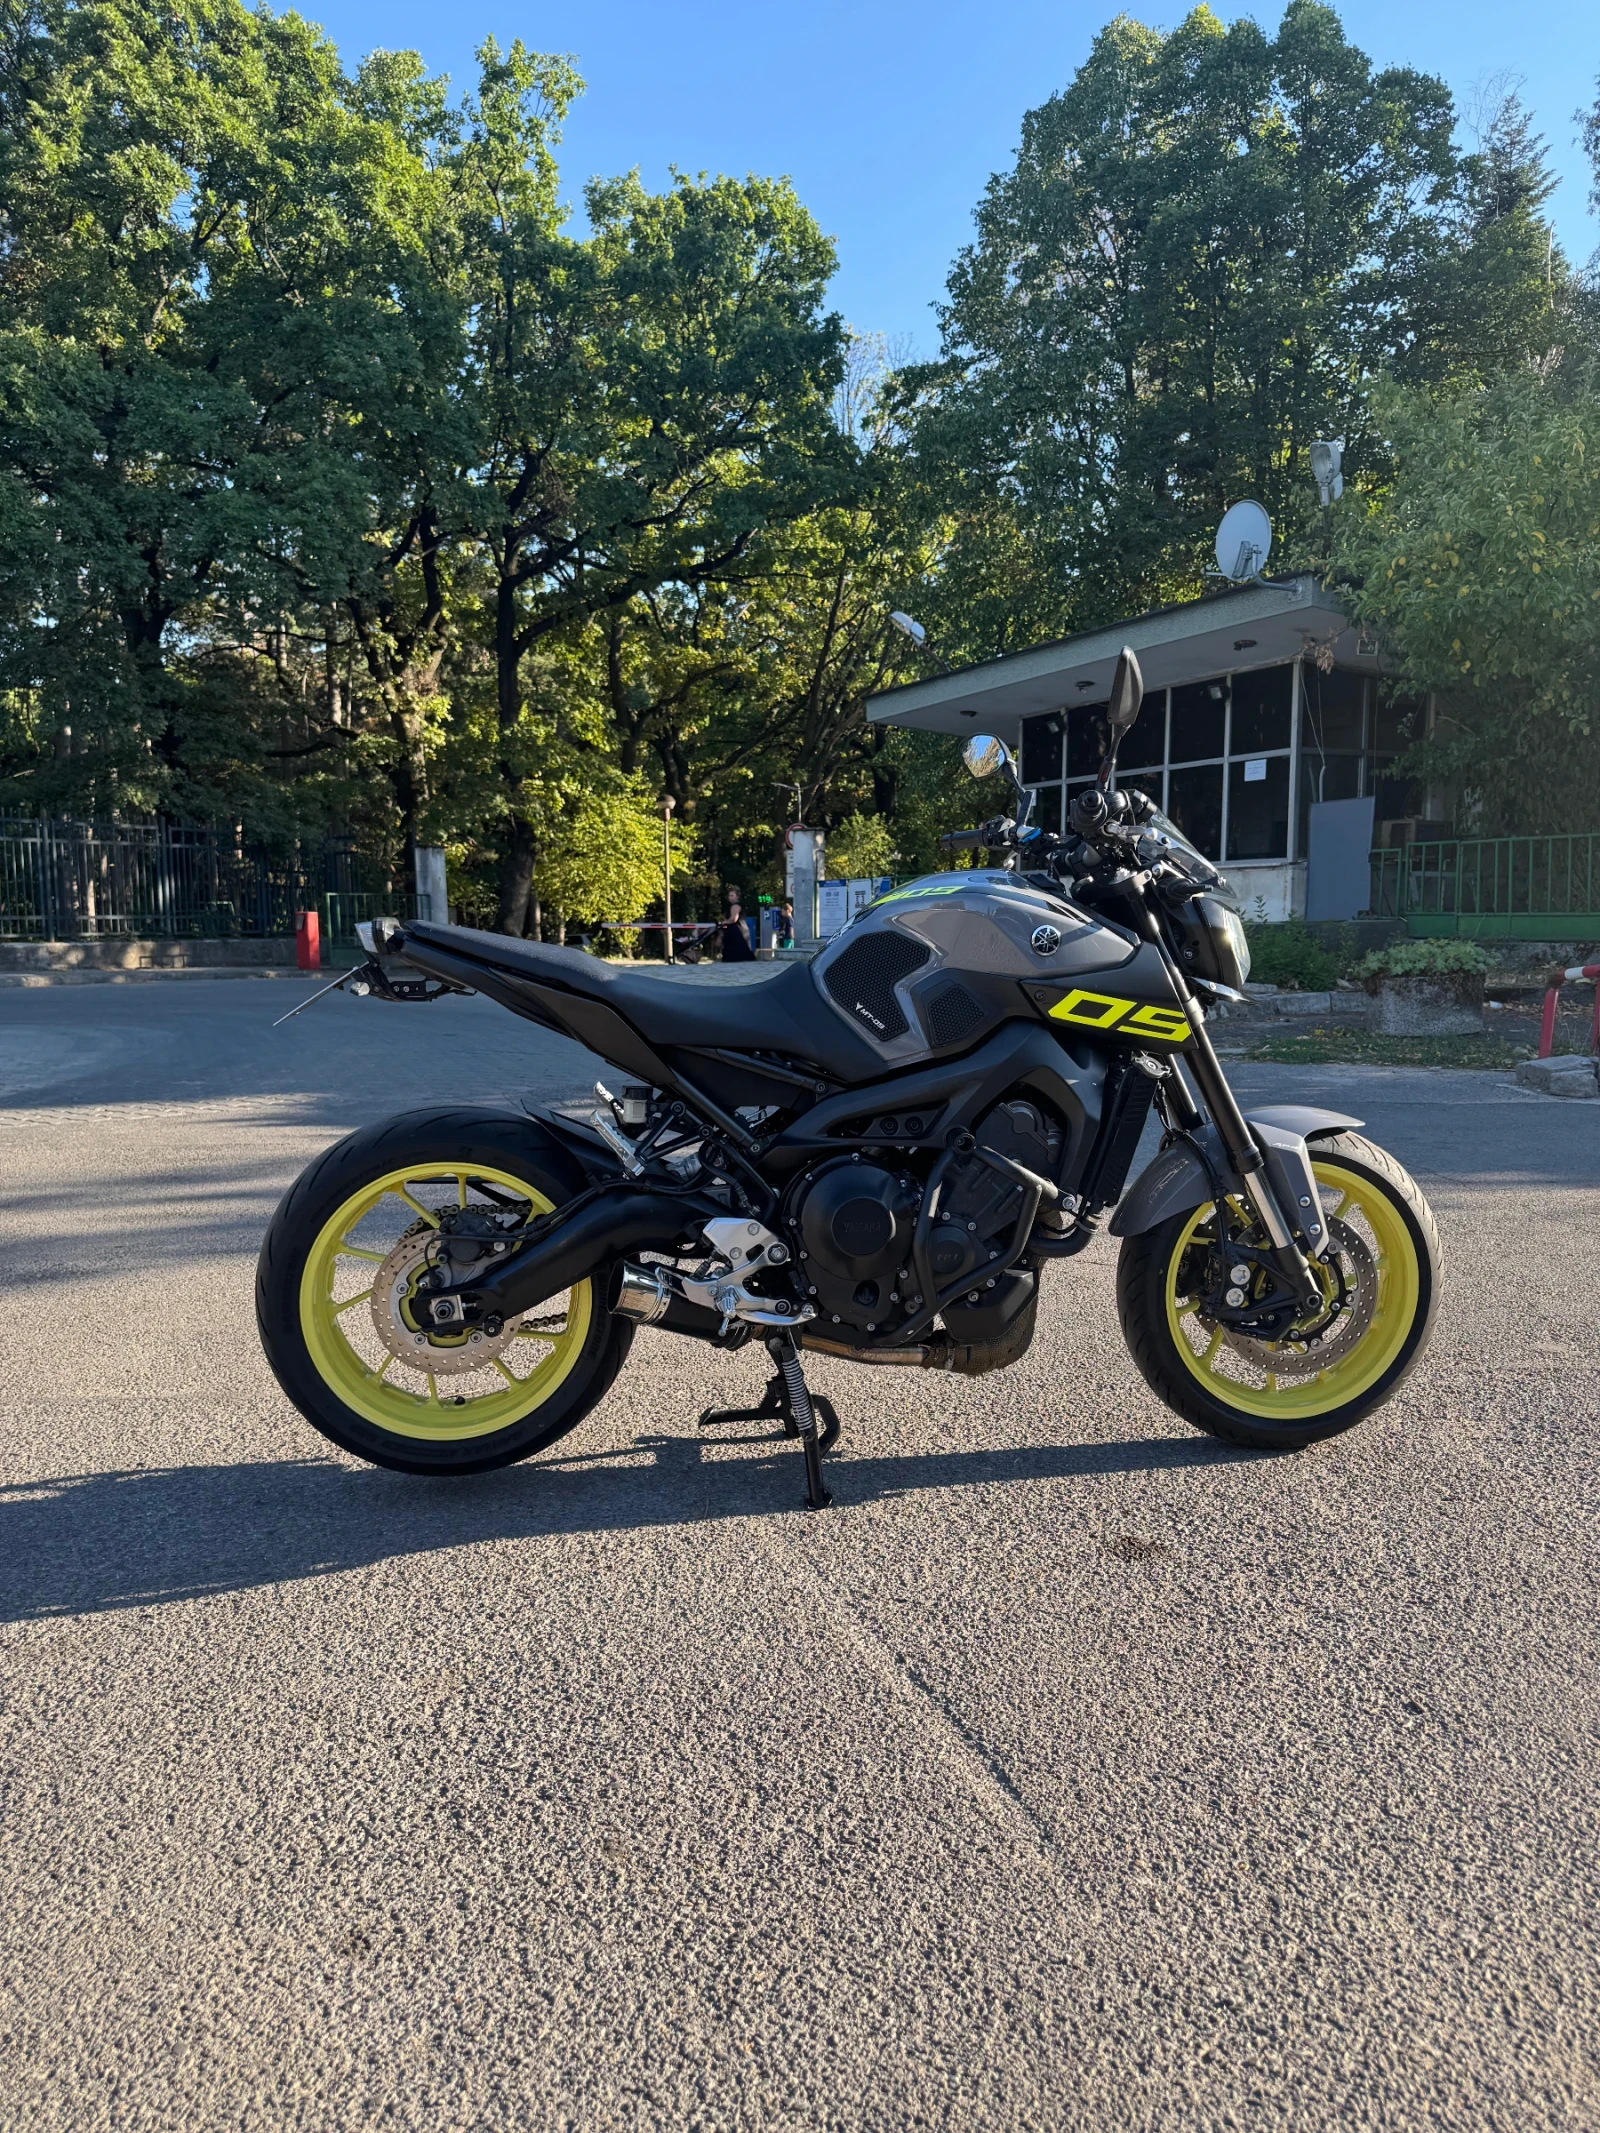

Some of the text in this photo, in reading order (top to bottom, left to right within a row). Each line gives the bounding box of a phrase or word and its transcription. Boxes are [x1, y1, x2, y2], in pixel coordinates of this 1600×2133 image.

[764, 911, 770, 920] P
[860, 1008, 886, 1030] MT-09
[1048, 988, 1192, 1042] 09
